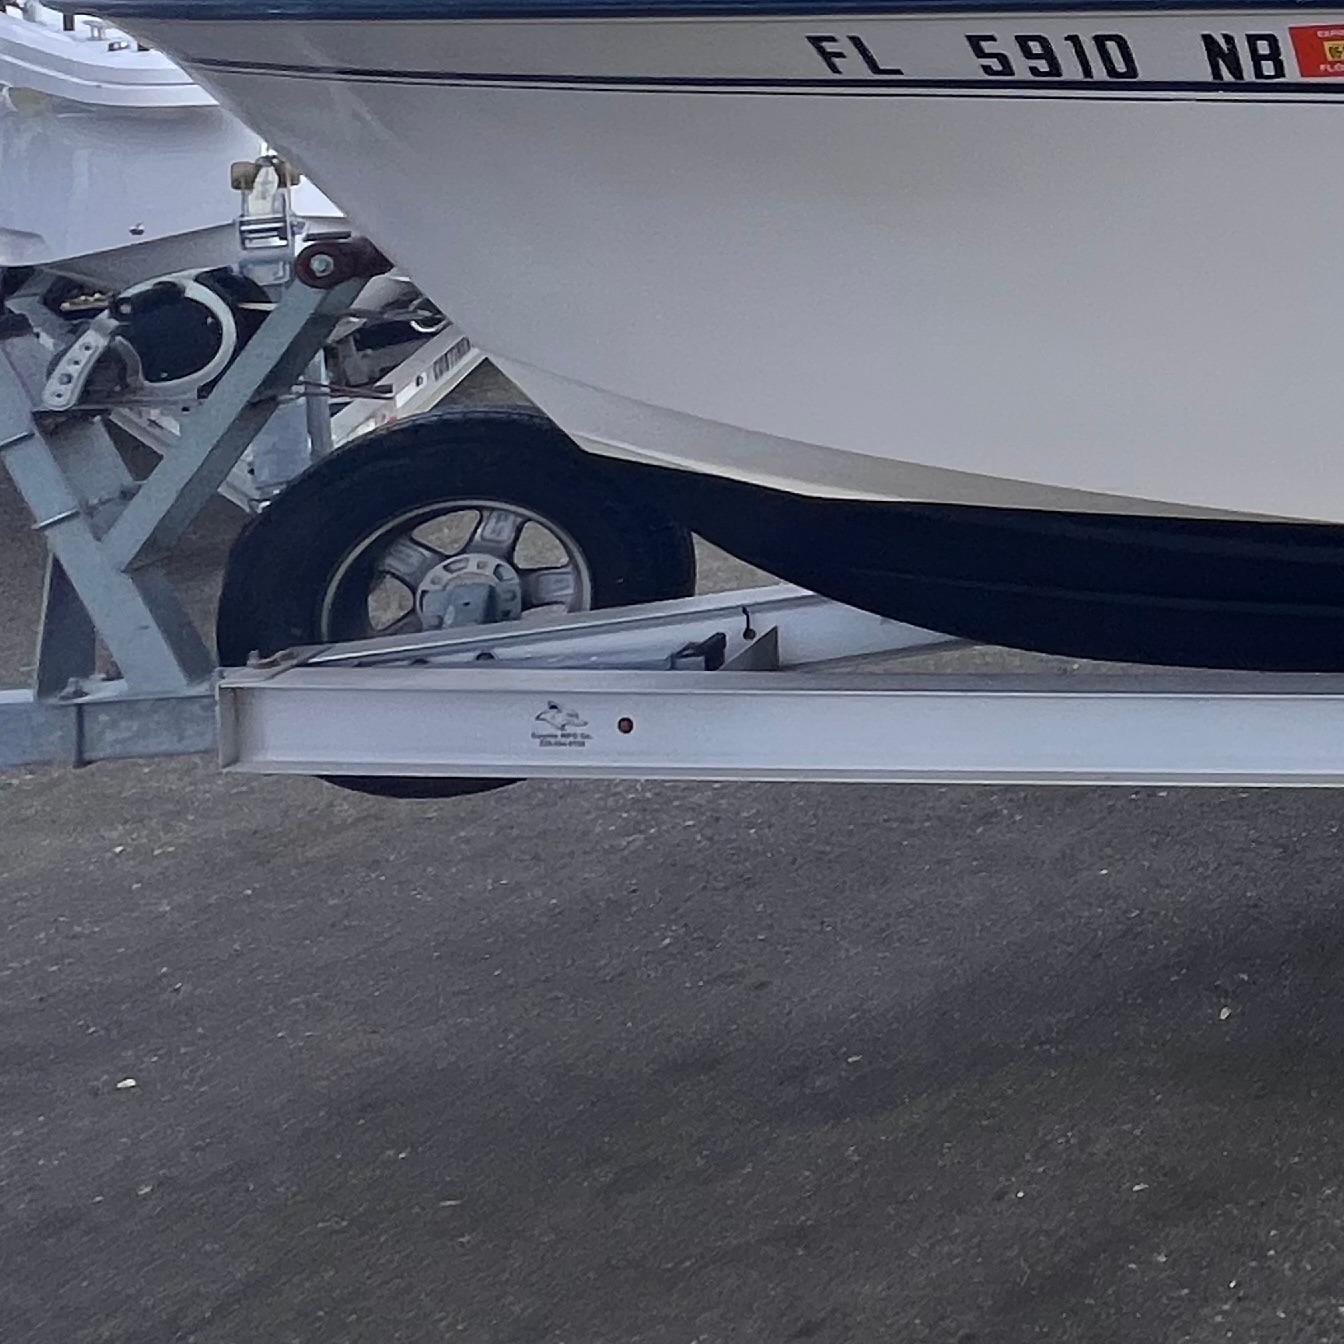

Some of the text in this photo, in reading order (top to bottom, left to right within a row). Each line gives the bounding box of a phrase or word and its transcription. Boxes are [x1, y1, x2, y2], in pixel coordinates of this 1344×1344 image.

[805, 33, 1287, 81] FL 5910 NB
